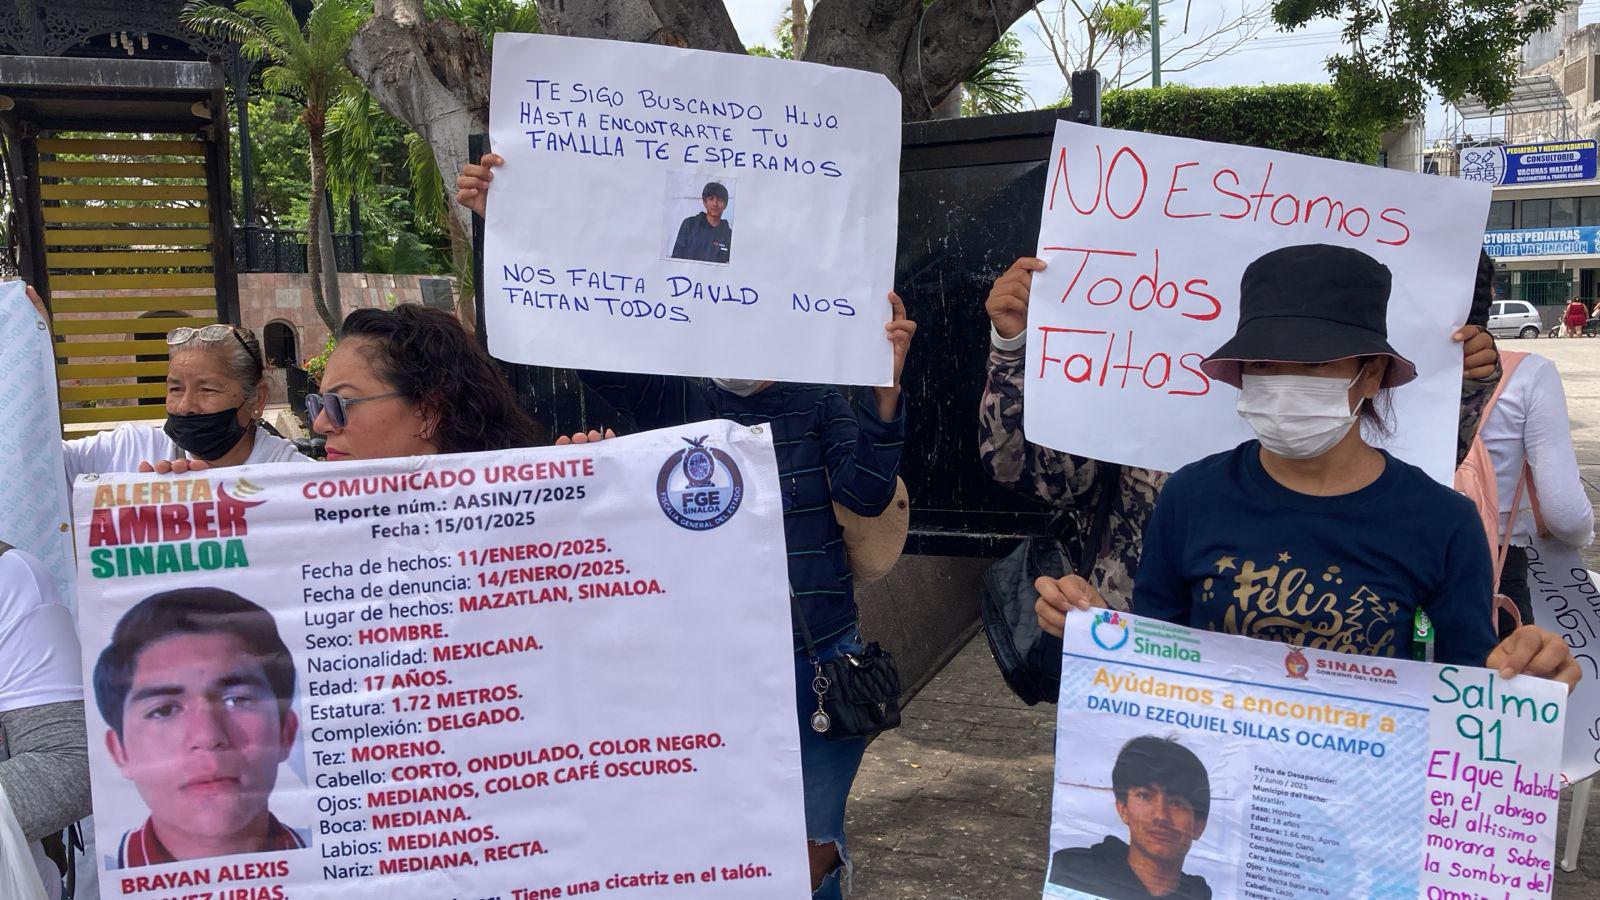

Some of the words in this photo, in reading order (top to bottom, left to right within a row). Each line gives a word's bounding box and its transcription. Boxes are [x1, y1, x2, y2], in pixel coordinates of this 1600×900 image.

[526, 79, 560, 102] TE
[571, 84, 624, 107] SIGO
[638, 90, 763, 121] BUSCANDO
[520, 102, 587, 128] HASTA
[600, 114, 733, 142] ENCONTRARTE
[752, 128, 788, 148] TU
[526, 131, 624, 157] FAMILIA
[636, 140, 669, 161] TE
[684, 145, 842, 177] ESPERAMOS
[1517, 167, 1547, 175] VACUNAS
[1527, 153, 1574, 162] CONSULTORIO
[1049, 145, 1147, 219] NO
[1504, 245, 1517, 255] DE
[1521, 239, 1588, 255] VACUNACIÓN
[503, 264, 555, 286] NOS
[566, 269, 645, 294] FALTA
[667, 277, 758, 306] DAVID
[792, 294, 856, 316] NOS
[1044, 247, 1221, 321] Todos
[503, 288, 590, 313] FALTAN
[595, 298, 692, 323] TODOS.
[1039, 327, 1211, 396] Faltas
[94, 479, 211, 508] ALERTA
[302, 469, 475, 501] COMUNICADO
[484, 458, 594, 484] URGENTE
[314, 504, 391, 523] Reporte
[397, 497, 447, 515] núm.:
[454, 485, 585, 511] AASIN/7/2025
[682, 491, 720, 507] FGE
[683, 505, 720, 515] SINALOA
[89, 499, 249, 547] AMBER
[371, 521, 419, 539] Fecha
[434, 511, 535, 535] 15/01/2025
[91, 539, 248, 578] SINALOA
[301, 562, 354, 581] Fecha
[360, 557, 382, 576] de
[387, 552, 452, 573] hechos:
[458, 538, 611, 569] 11/ENERO/2025.
[303, 585, 356, 604] Fecha
[361, 581, 382, 599] de
[389, 575, 471, 597] denuncia:
[477, 559, 630, 588] 14/ENERO/2025.
[1232, 560, 1343, 636] Feliz
[304, 608, 354, 630] Lugar
[360, 604, 383, 622] de
[389, 599, 453, 619] hechos:
[459, 586, 573, 614] MAZATLAN,
[578, 579, 666, 600] SINALOA.
[305, 631, 353, 650] Sexo:
[359, 623, 448, 646] HOMBRE.
[307, 648, 427, 673] Nacionalidad:
[433, 635, 543, 663] MEXICANA.
[1134, 637, 1200, 662] Sinaloa
[309, 678, 357, 696] Edad:
[364, 674, 385, 692] 17
[391, 668, 452, 689] AÑOS.
[1316, 659, 1396, 678] SINALOA
[1316, 670, 1352, 678] GOBIERNO
[1369, 676, 1397, 684] ESTADO
[311, 699, 385, 721] Estatura:
[391, 694, 431, 714] 1.72
[436, 684, 523, 709] METROS.
[1093, 667, 1214, 705] Ayúdanos
[1223, 695, 1234, 708] a
[1243, 696, 1371, 729] encontrar
[1380, 716, 1396, 733] a
[1432, 666, 1559, 724] Salmo
[312, 719, 421, 744] Complexión:
[427, 705, 525, 733] DELGADO.
[1087, 695, 1140, 717] DAVID
[1146, 706, 1228, 734] EZEQUIEL
[1233, 721, 1290, 743] SILLAS
[1296, 730, 1386, 758] OCAMPO
[1456, 714, 1517, 764] 91
[313, 749, 345, 767] Tez:
[351, 740, 445, 763] MORENO.
[315, 767, 386, 789] Cabello:
[391, 760, 461, 783] CORTO,
[467, 743, 584, 775] ONDULADO,
[589, 737, 651, 757] COLOR
[656, 732, 726, 753] NEGRO.
[317, 795, 362, 814] Ojos:
[367, 782, 479, 809] MEDIANOS,
[484, 772, 548, 795] COLOR
[554, 760, 599, 784] CAFÉ
[604, 757, 697, 779] OSCUROS.
[1253, 784, 1288, 796] Municipio
[1254, 765, 1275, 774] Fecha
[1288, 771, 1336, 784] Desaparición:
[1290, 781, 1308, 789] 2025
[319, 816, 367, 835] Boca:
[372, 806, 471, 830] MEDIANA.
[1251, 814, 1270, 823] Edad:
[1272, 808, 1301, 819] Hombre
[1429, 808, 1457, 828] del
[1466, 812, 1537, 843] altisimo
[1431, 790, 1454, 806] en
[1461, 792, 1481, 812] el
[1494, 795, 1547, 825] abrigo
[321, 839, 382, 858] Labios:
[388, 825, 499, 852] MEDIANOS.
[323, 861, 373, 880] Nariz:
[379, 852, 479, 875] MEDIANA,
[484, 840, 548, 863] RECTA.
[1427, 834, 1495, 857] morara
[122, 869, 210, 894] BRAYAN
[218, 860, 288, 882] ALEXIS
[511, 885, 561, 900] Tiene
[567, 880, 600, 896] una
[605, 869, 669, 891] cicatriz
[674, 869, 696, 885] en
[701, 865, 716, 882] el
[721, 861, 772, 881] talón.
[1424, 853, 1439, 873] la
[1527, 873, 1551, 894] del
